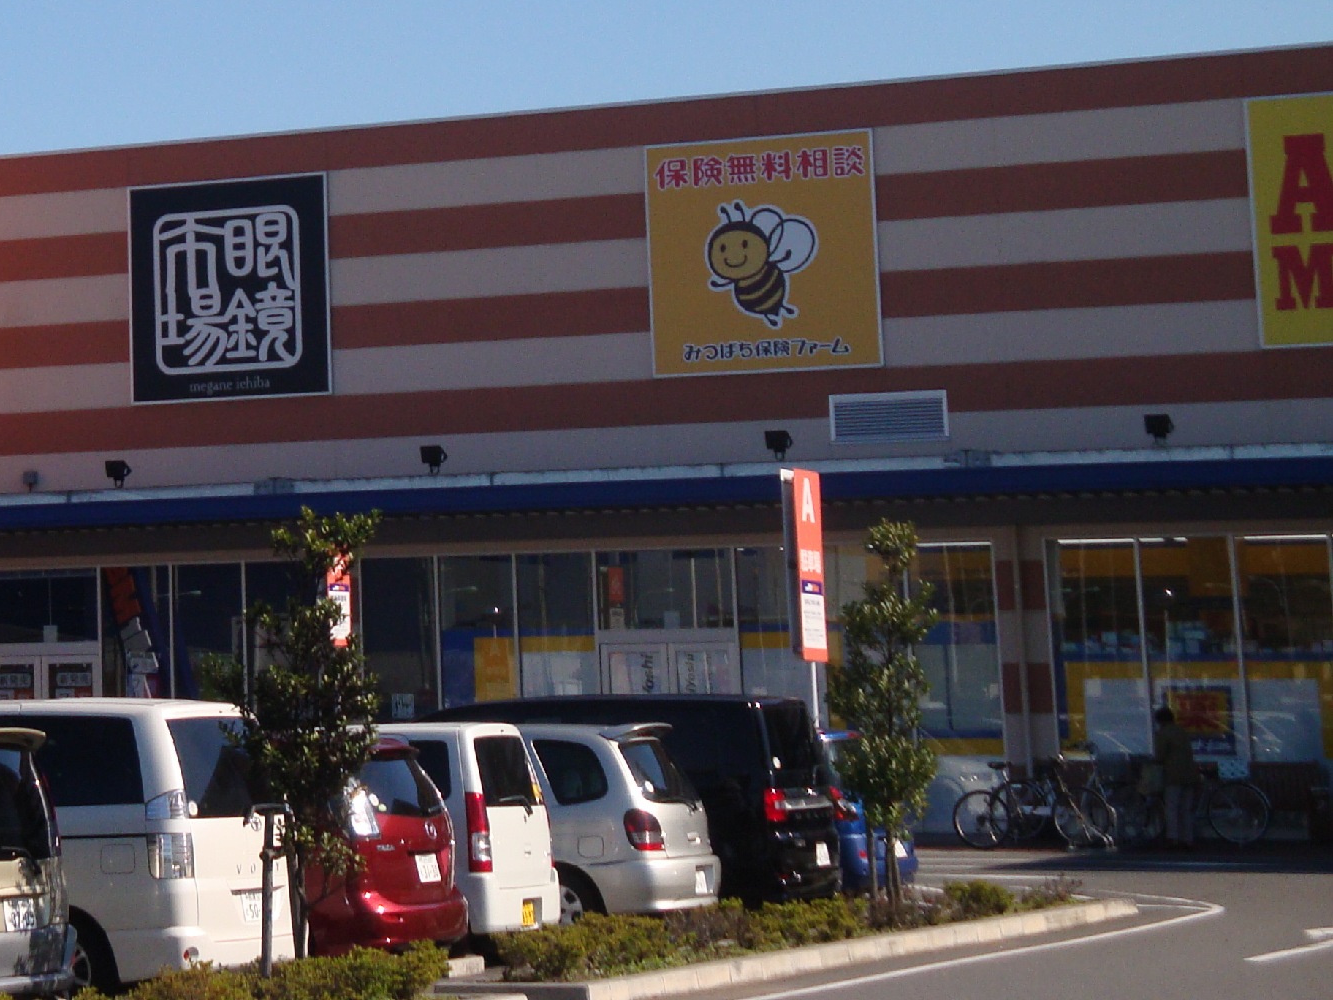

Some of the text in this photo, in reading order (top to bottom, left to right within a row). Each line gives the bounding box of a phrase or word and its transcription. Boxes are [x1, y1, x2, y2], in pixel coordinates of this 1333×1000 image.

[654, 146, 866, 190] 保険無料相談
[683, 338, 851, 362] みつばち保険ファーム
[802, 477, 816, 523] A
